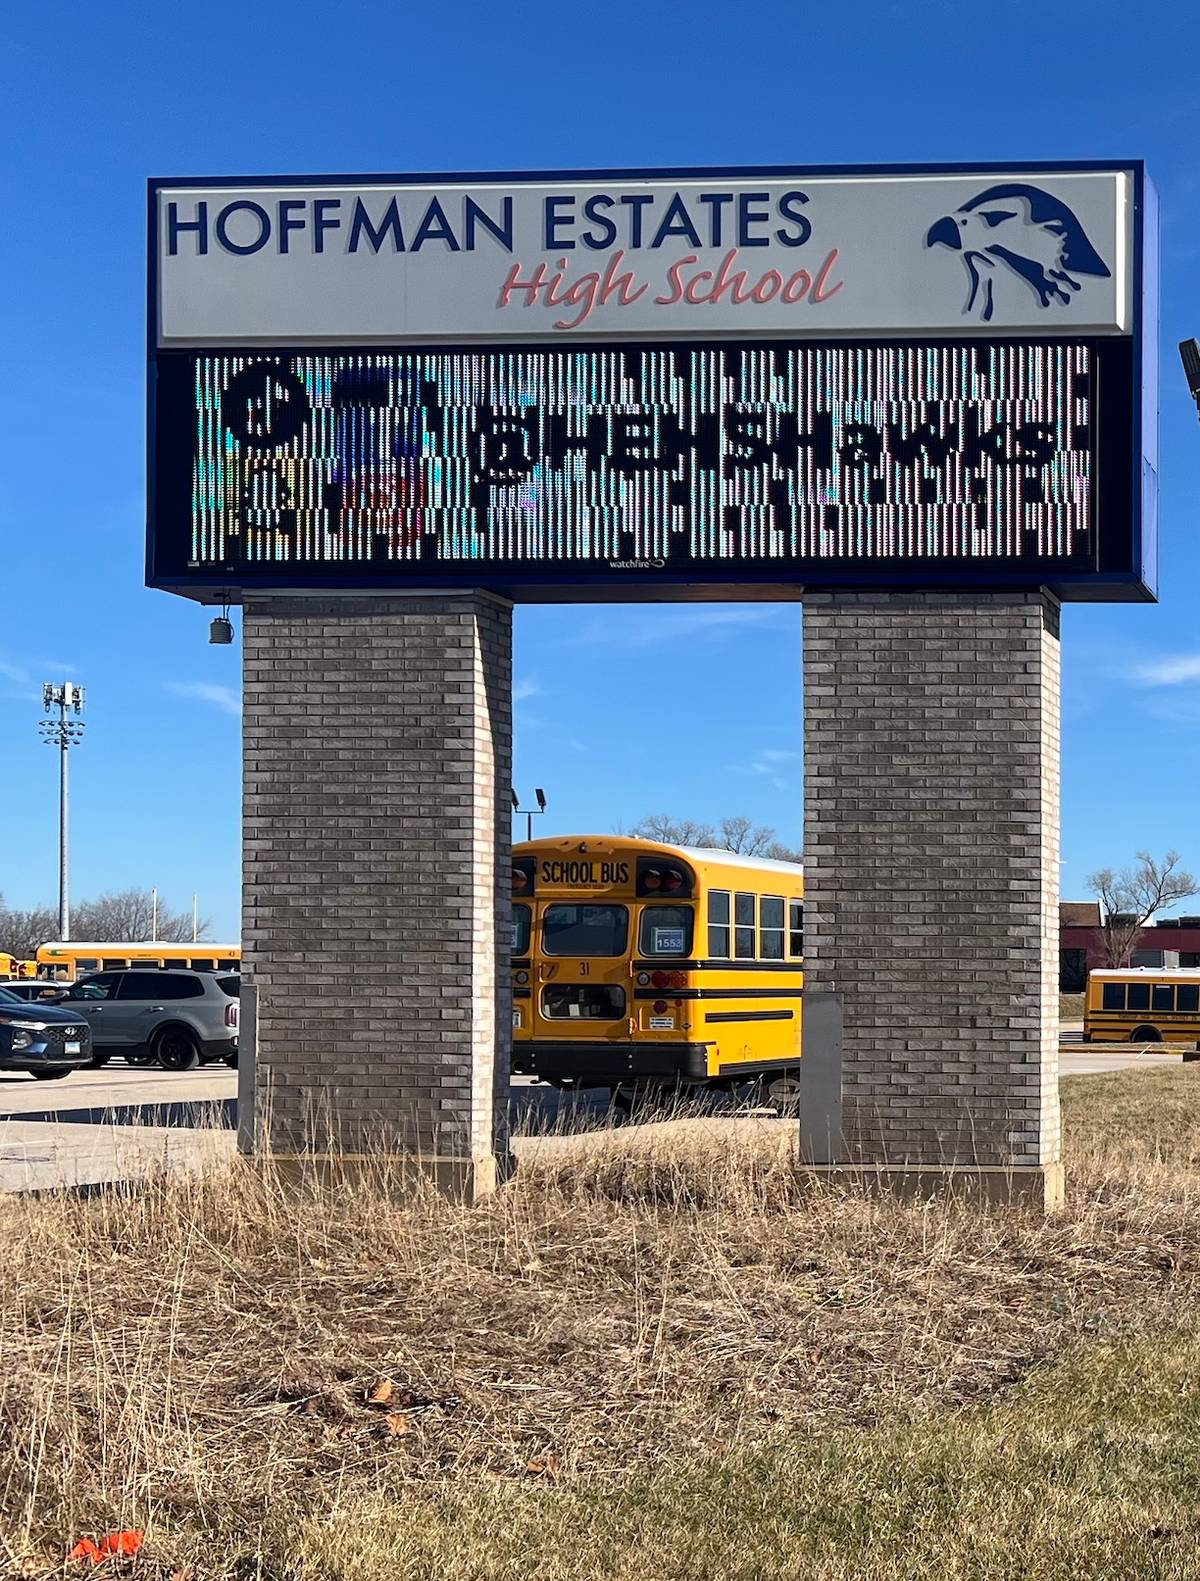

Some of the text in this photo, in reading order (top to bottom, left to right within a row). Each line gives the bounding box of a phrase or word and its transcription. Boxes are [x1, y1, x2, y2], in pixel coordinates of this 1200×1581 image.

[167, 191, 812, 255] HOFFMAN ESTATES
[498, 248, 843, 329] High School
[609, 559, 650, 569] watchfire
[542, 861, 629, 884] SCHOOL BUS
[579, 961, 590, 976] 31
